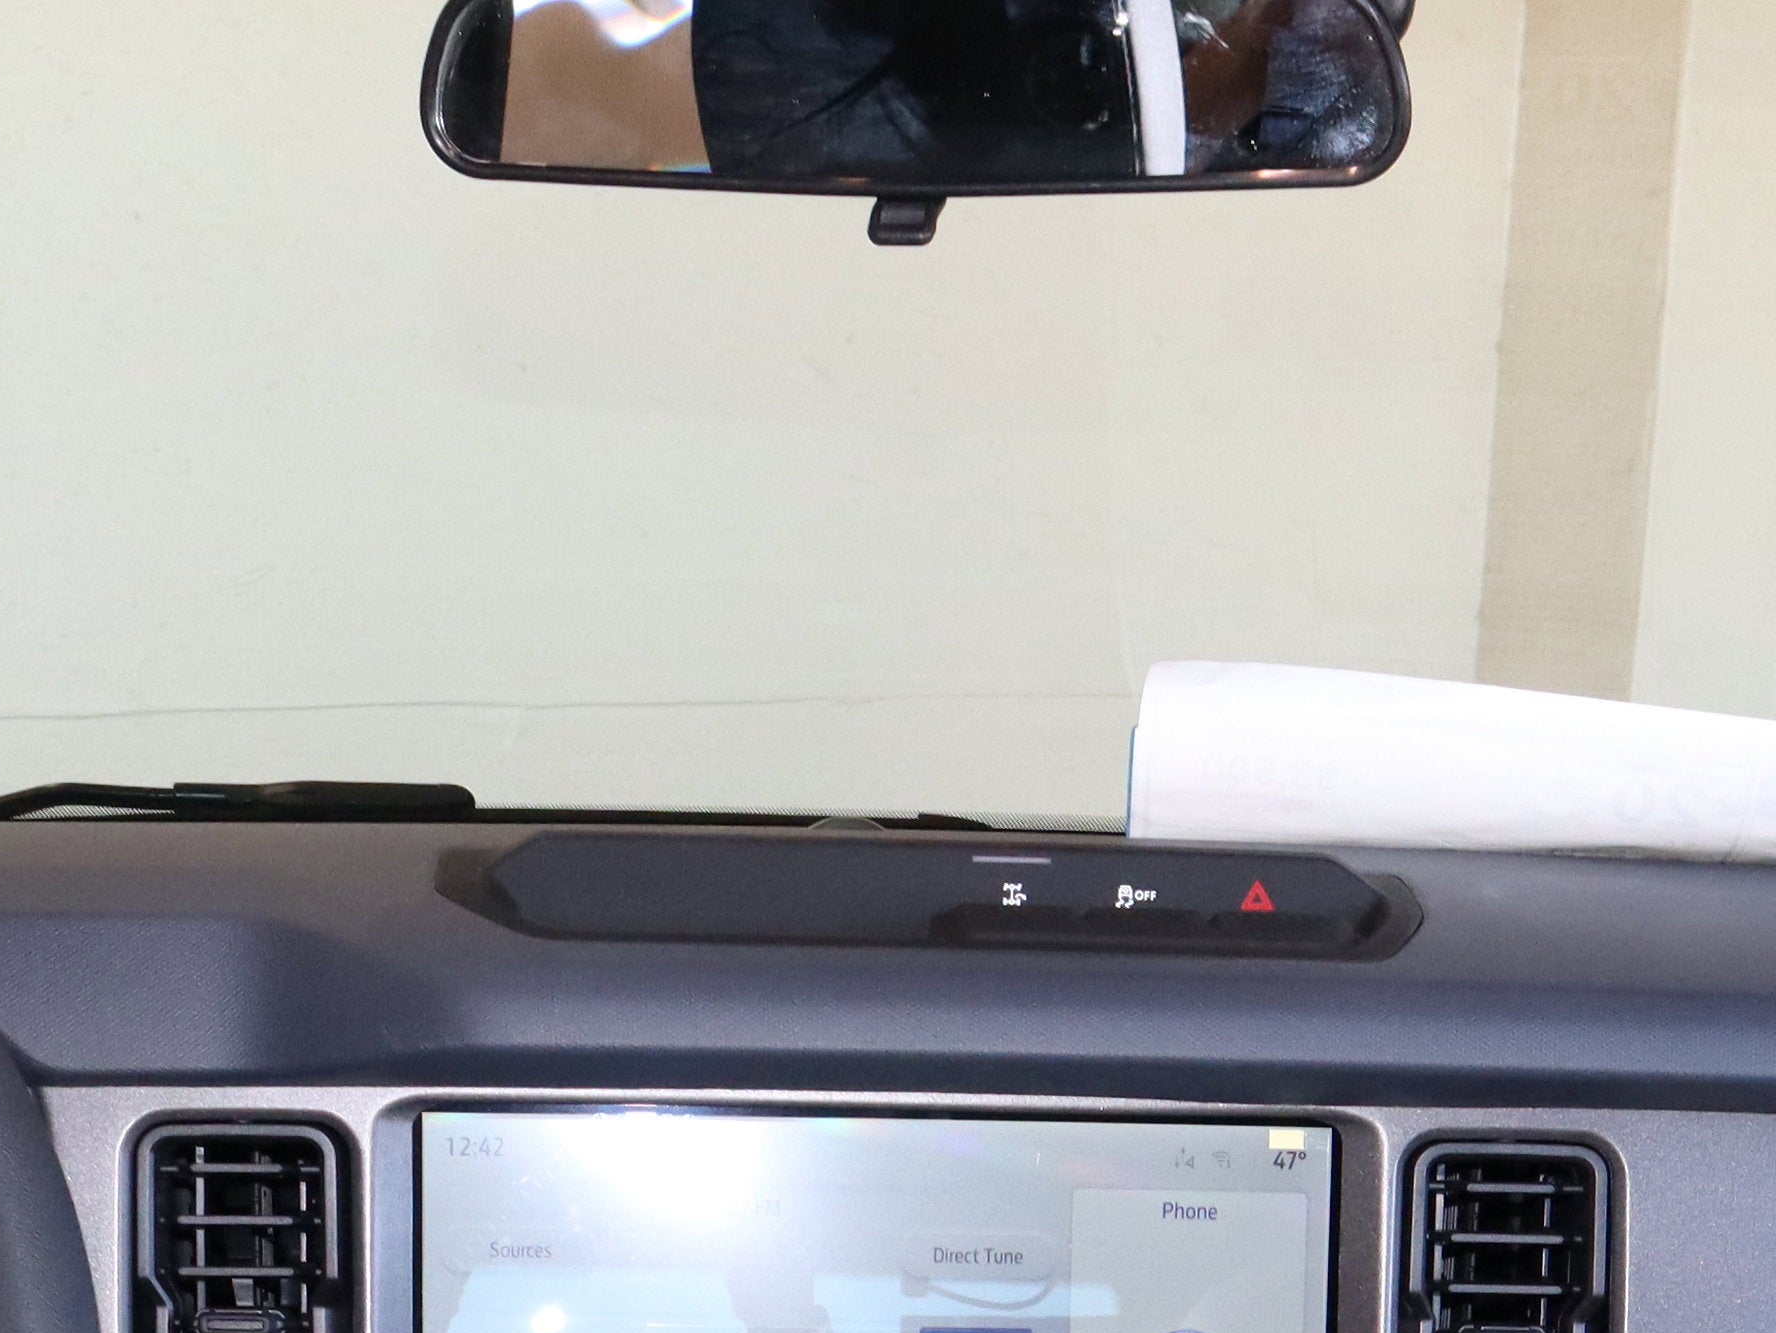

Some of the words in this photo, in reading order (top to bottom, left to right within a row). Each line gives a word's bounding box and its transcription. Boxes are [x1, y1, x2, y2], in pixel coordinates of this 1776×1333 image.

[1134, 889, 1157, 902] OFF
[446, 1137, 505, 1157] 12:42
[1162, 1202, 1218, 1221] Phone
[489, 1242, 552, 1259] Sources
[933, 1247, 979, 1265] Direct
[984, 1248, 1024, 1265] Tune
